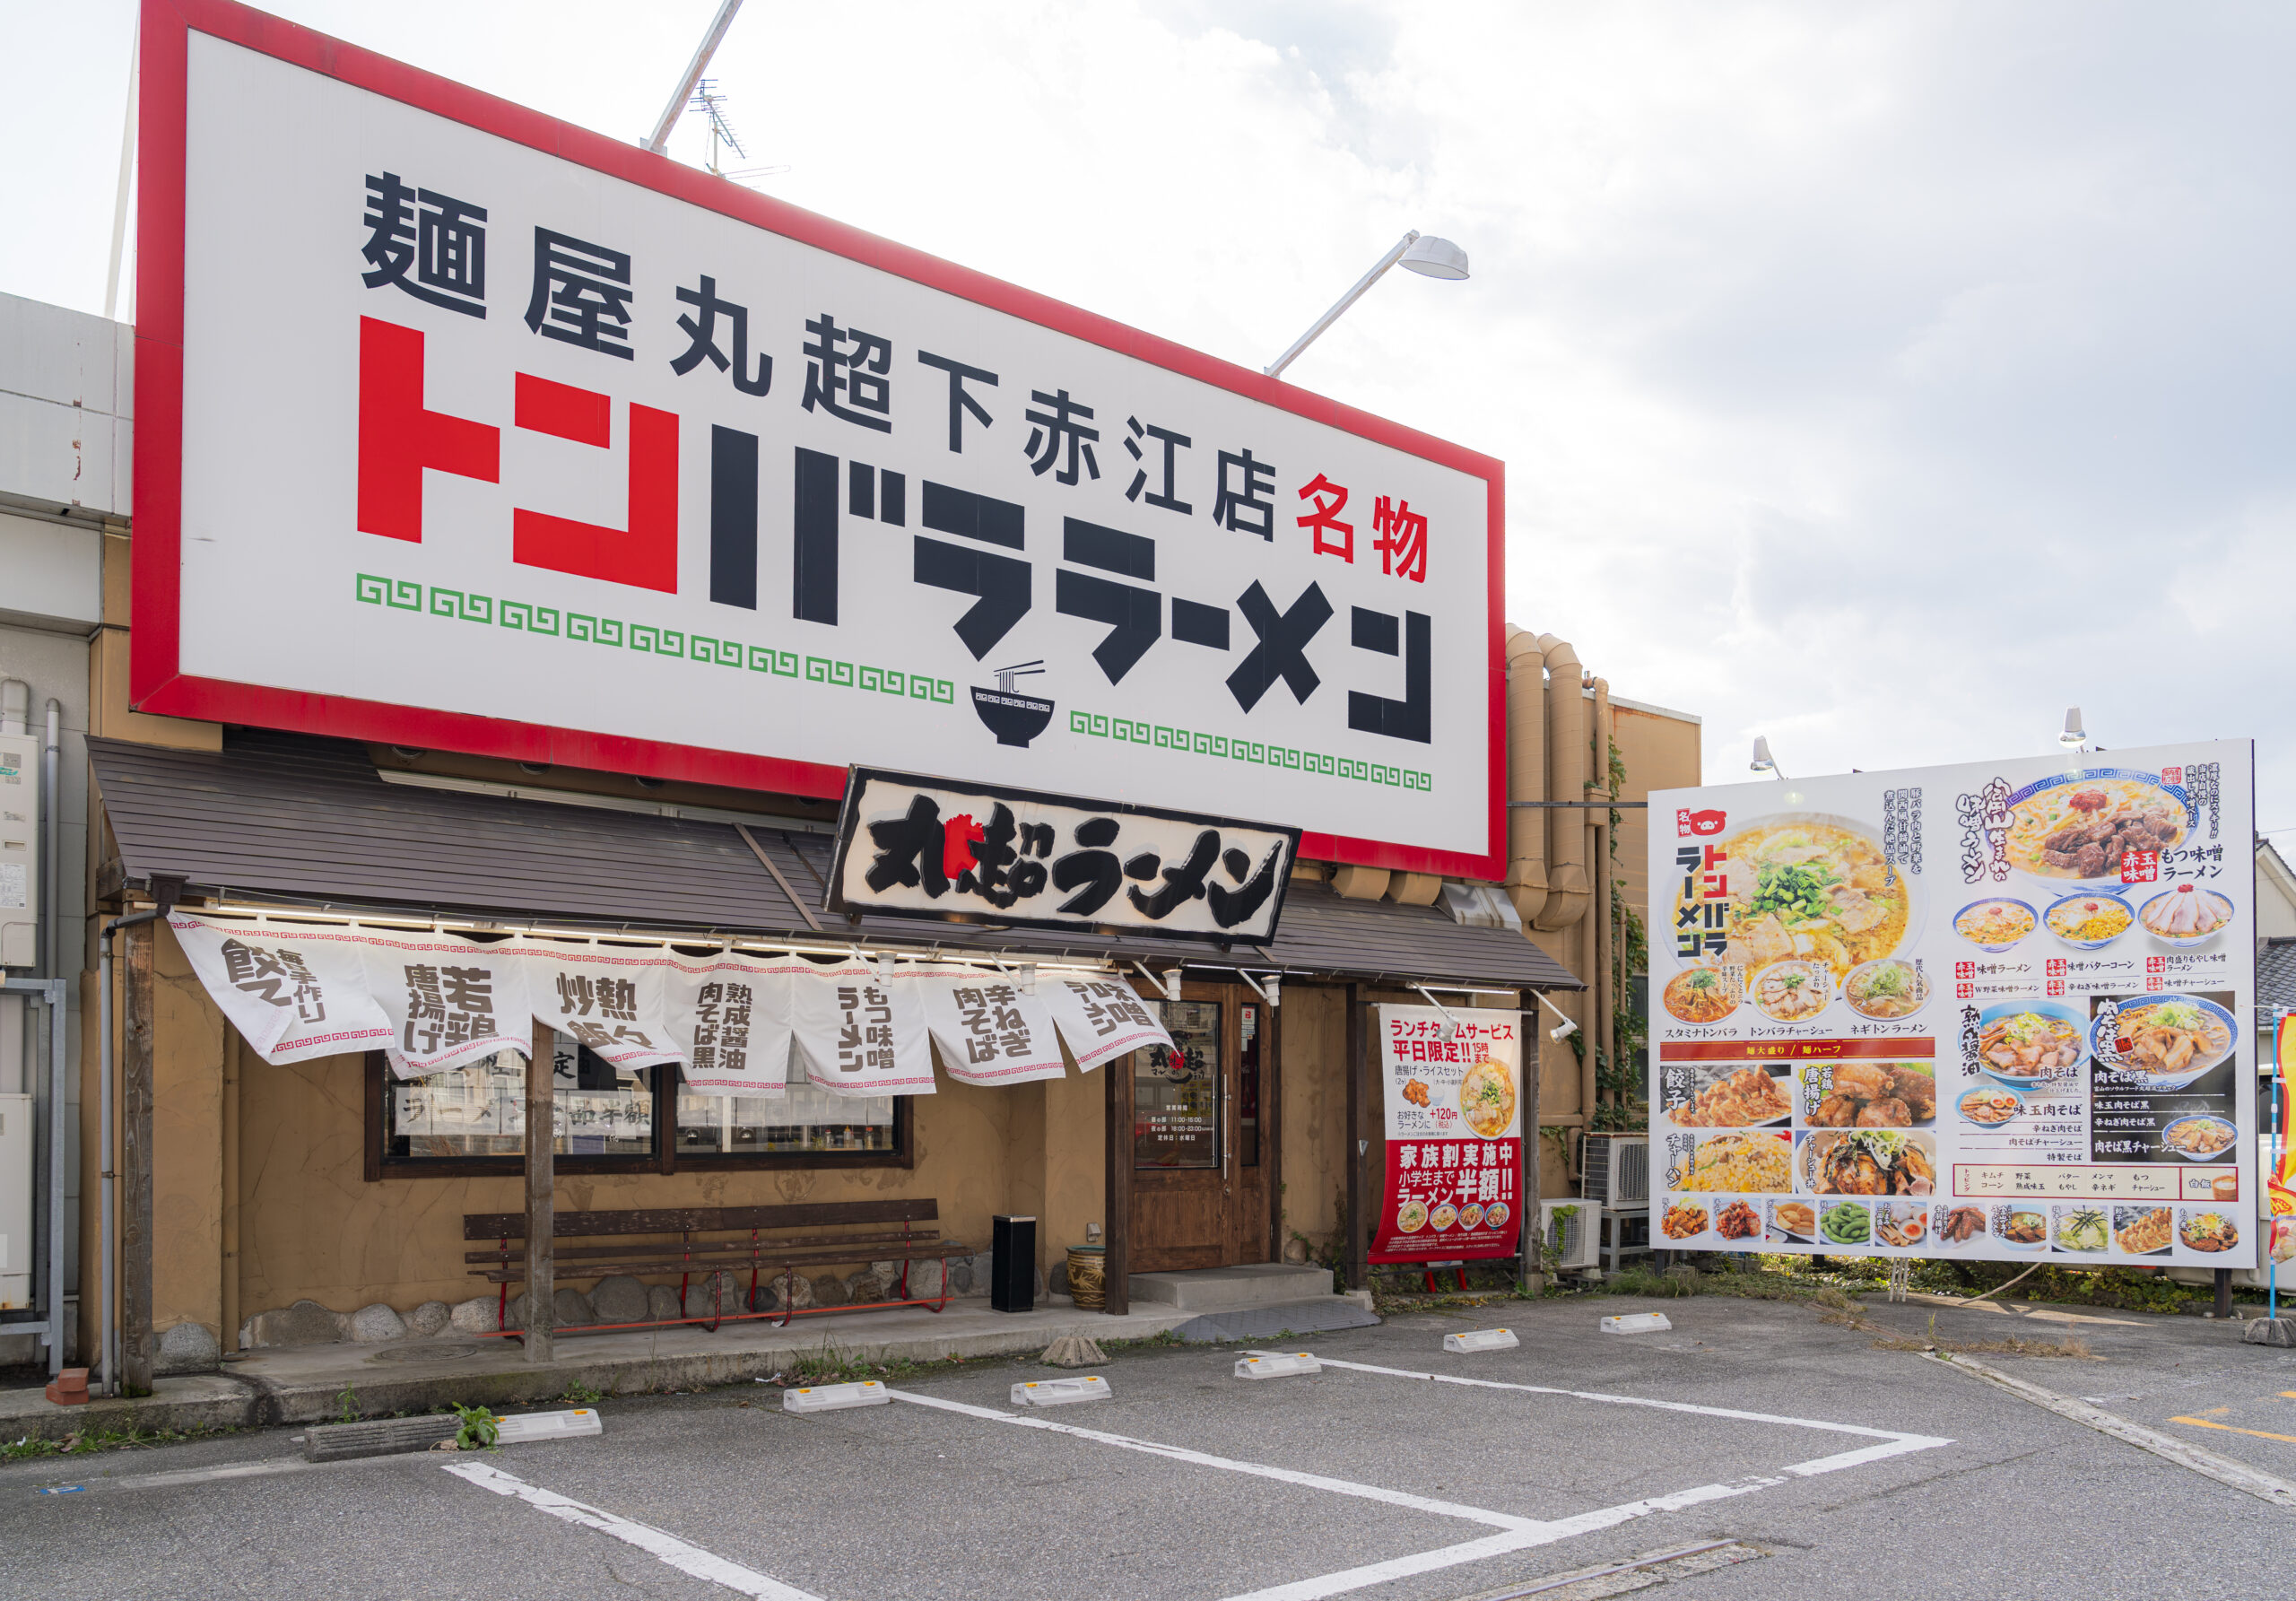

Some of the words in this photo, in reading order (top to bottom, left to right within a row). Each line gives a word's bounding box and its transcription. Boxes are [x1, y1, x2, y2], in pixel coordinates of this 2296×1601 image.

[361, 171, 1275, 543] 麺屋丸超下赤江店
[357, 314, 1431, 744] トンバララーメン
[1296, 473, 1427, 583] 名物
[2197, 764, 2207, 805] 当店自慢の
[1677, 810, 1692, 837] 名物
[1897, 789, 1909, 864] 関西風甘醤油で
[1910, 787, 1922, 874] 豚バラ肉と野菜を
[1884, 790, 1896, 886] 煮込んだ絶品スープ
[1956, 794, 1986, 883] 味噌ラーメン
[2123, 852, 2156, 867] 赤玉
[2161, 844, 2223, 865] もつ味噌
[2123, 867, 2156, 882] 味噌
[2163, 865, 2223, 882] ラーメン
[1676, 846, 1702, 957] ラーメン
[1704, 844, 1729, 957] トンバラ
[2067, 961, 2135, 971] 味噌バターコーン
[2166, 953, 2226, 964] 肉盛りもやし味噌
[1977, 963, 2031, 975] 味噌ラーメン
[2167, 964, 2193, 972] ラーメン
[1975, 985, 2039, 994] W野菜味噌ラーメン
[2068, 982, 2139, 992] 辛ねぎ味噌ラーメン
[2164, 979, 2225, 988] 味噌チャーシュー
[404, 963, 446, 1055] 唐揚げ
[442, 966, 500, 1048] 若鶏
[556, 971, 623, 1048] 炒飯
[1064, 981, 1117, 1037] ラーメン
[1085, 982, 1155, 1027] 味噌
[596, 977, 657, 1050] 熱々
[984, 985, 1032, 1059] 辛ねぎ
[692, 982, 721, 1070] 肉そば黒
[718, 982, 752, 1070] 熟成醤油
[838, 987, 863, 1072] ラーメン
[865, 986, 894, 1070] もつ味噌
[953, 988, 998, 1065] 肉そば
[1390, 1020, 1514, 1040] ランチタムサービス
[1665, 1027, 1738, 1039] スタミナトンバラ
[1750, 1026, 1833, 1038] トンバラチャーシュー
[1851, 1023, 1928, 1035] ネギトンラーメン
[2096, 998, 2124, 1063] 肉そば黒
[1392, 1040, 1472, 1063] 平日限定!!
[1472, 1042, 1489, 1054] 15時
[1746, 1045, 1786, 1056] 麺大盛り
[1802, 1044, 1841, 1055] 麺ハーフ
[1474, 1053, 1490, 1064] まで
[1821, 1066, 1834, 1091] 若鶏
[2039, 1066, 2079, 1079] 肉そば
[2094, 1070, 2149, 1083] 肉そば黒
[1665, 1067, 1686, 1111] 餃子
[1804, 1067, 1822, 1117] 唐揚げ
[2013, 1103, 2083, 1117] 味玉肉そば
[2094, 1100, 2150, 1110] 味玉肉そば黒
[1397, 1110, 1424, 1120] お好きな
[2094, 1117, 2156, 1127] 辛ねぎ肉そば黒
[1397, 1120, 1431, 1129] ラーメンに
[2032, 1124, 2083, 1134] 辛ねぎ肉そば
[2008, 1137, 2083, 1146] 肉そばチャーシュー
[2094, 1140, 2187, 1154] 肉そば黒チャーシュー
[1399, 1142, 1513, 1170] 家族割実施中
[1665, 1133, 1682, 1188] チャーハン
[1805, 1135, 1816, 1189] チャーシュー丼
[2046, 1153, 2083, 1162] 特製そば
[1398, 1170, 1455, 1188] 小学生まで
[2015, 1172, 2031, 1180] 野菜
[2057, 1172, 2081, 1180] バター
[2091, 1172, 2115, 1180] メンマ
[2133, 1173, 2150, 1181] もつ
[2188, 1178, 2213, 1189] 白飯
[1980, 1181, 2005, 1189] コーン
[2015, 1182, 2046, 1191] 熟成味玉
[2058, 1183, 2078, 1191] もやし
[2091, 1183, 2117, 1192] 辛ネギ
[1397, 1187, 1454, 1208] ラーメン
